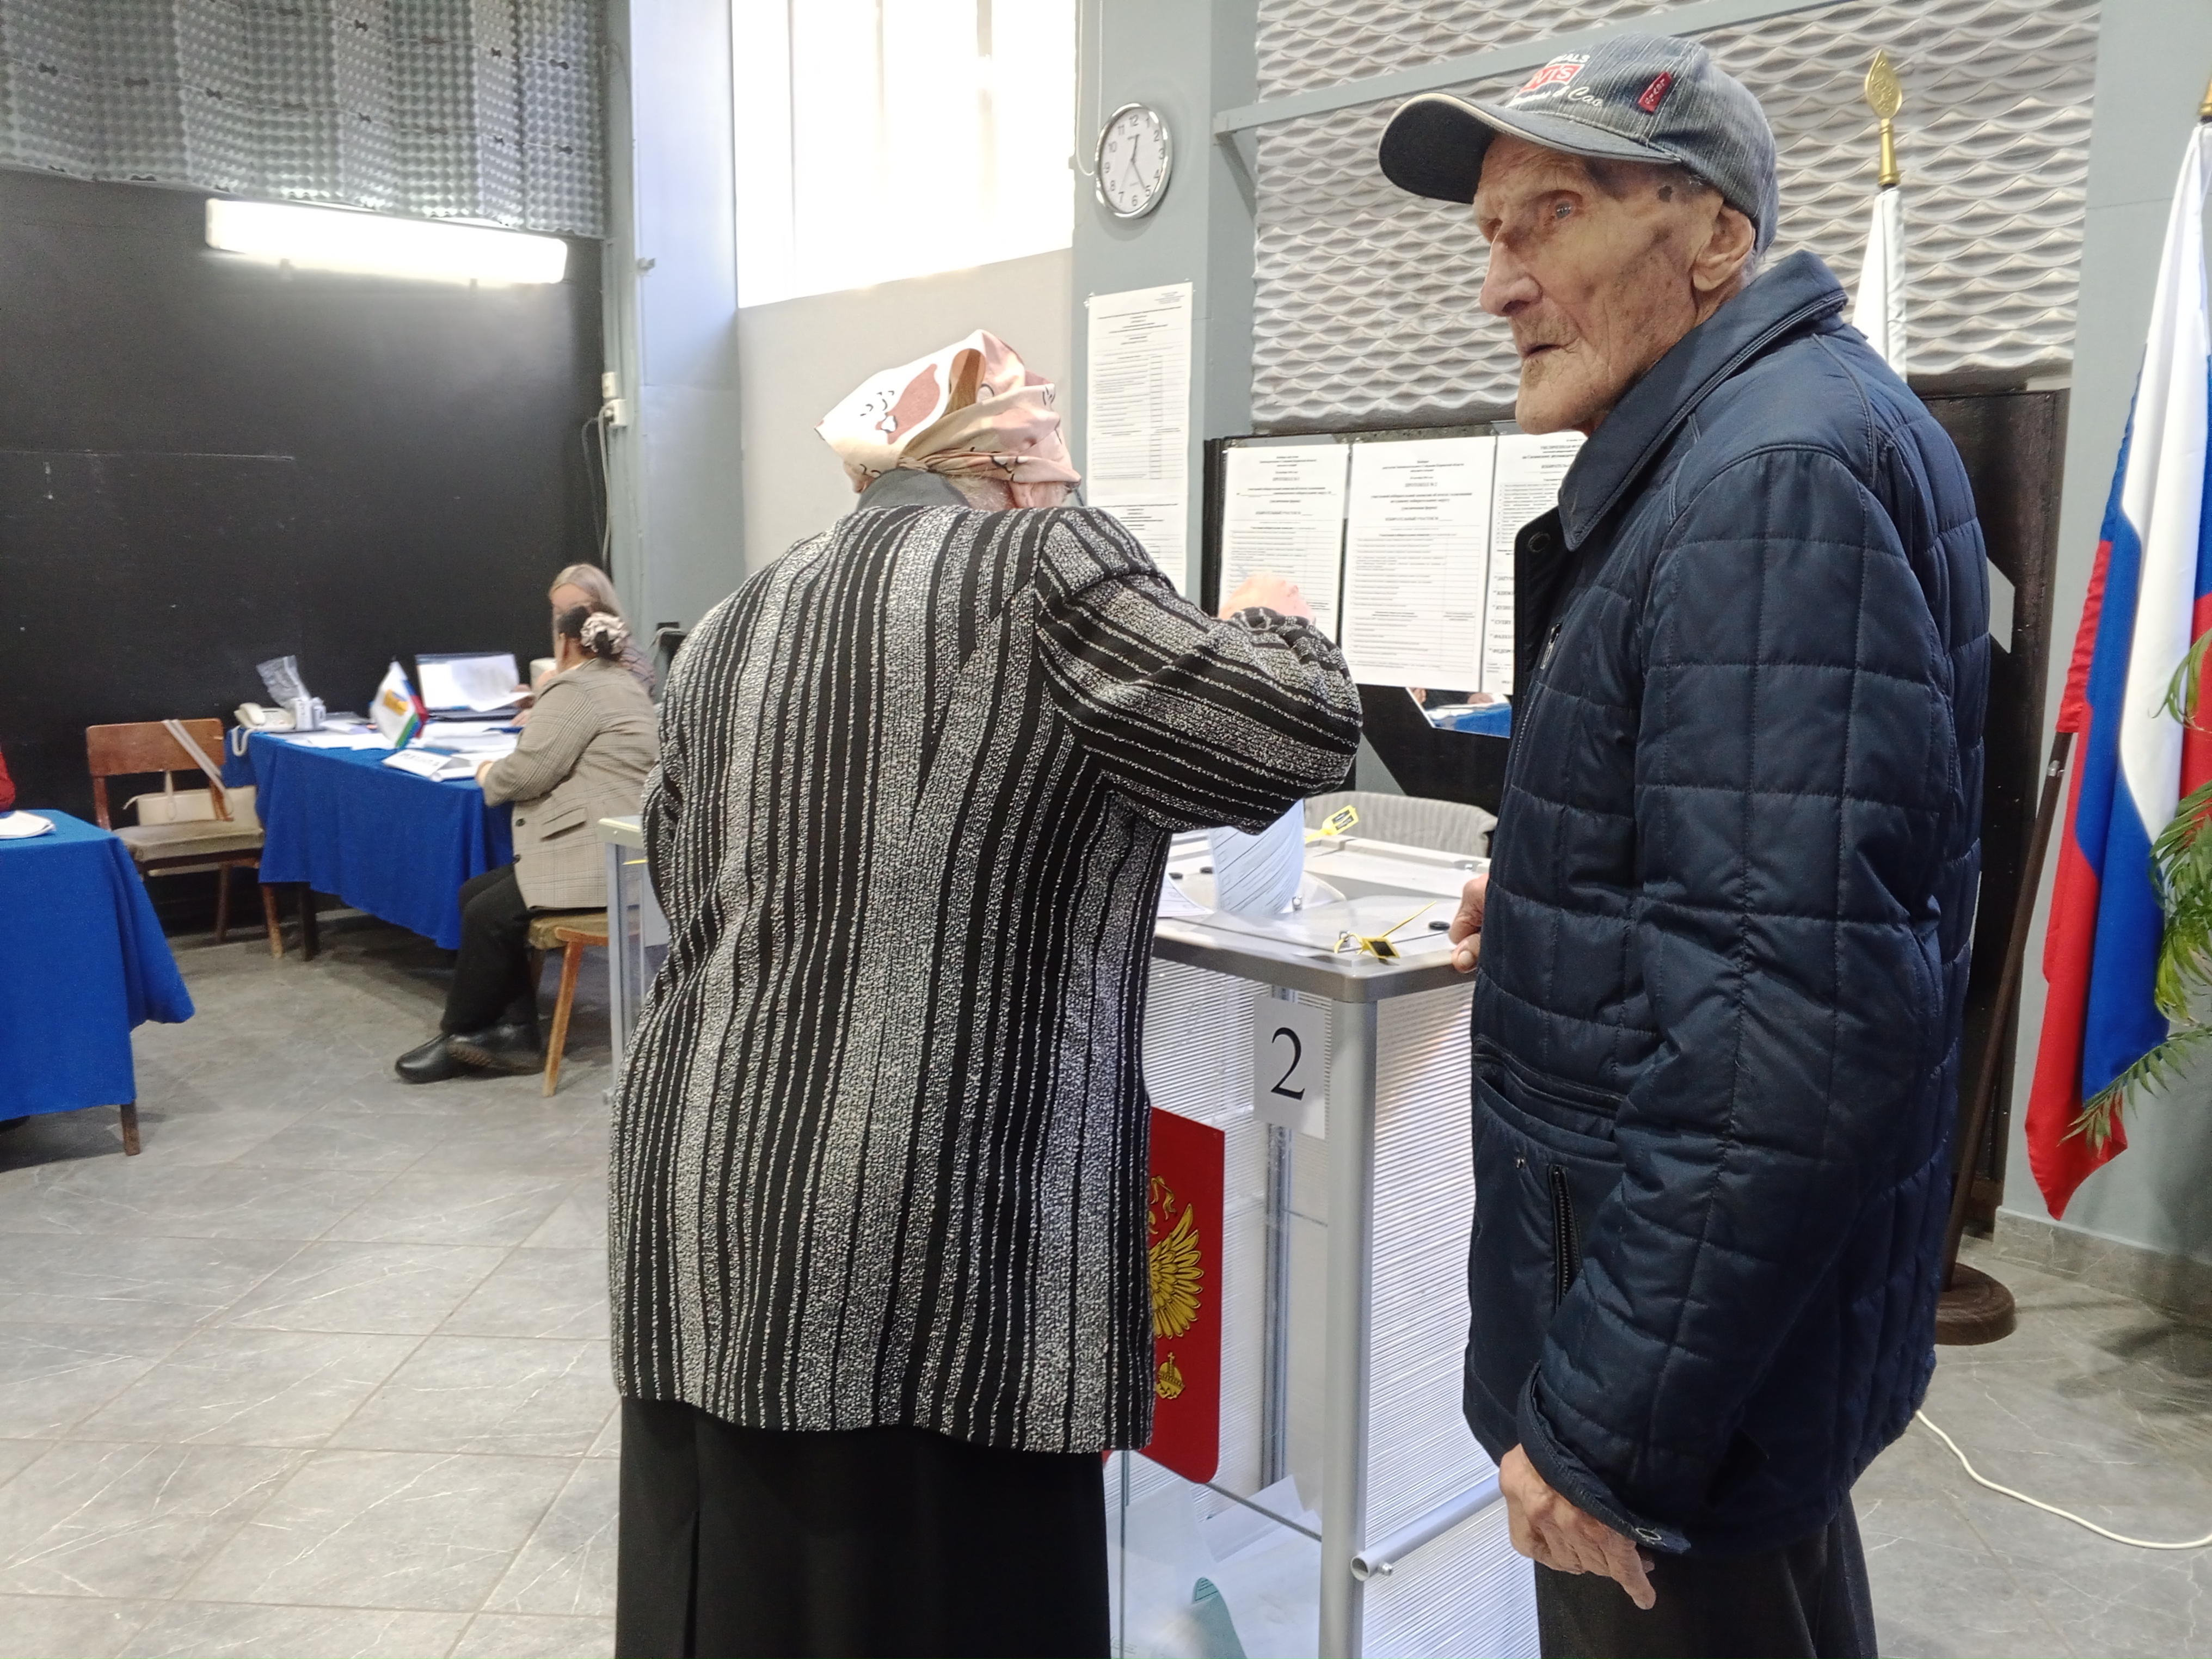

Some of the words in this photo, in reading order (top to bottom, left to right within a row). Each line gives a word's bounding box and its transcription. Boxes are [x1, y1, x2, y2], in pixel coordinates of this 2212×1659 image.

[1128, 114, 1139, 126] 12
[1145, 117, 1150, 128] 1
[1117, 125, 1125, 136] 11
[1153, 130, 1160, 142] 2
[1108, 141, 1117, 153] 10
[1158, 148, 1165, 160] 3
[1103, 162, 1110, 174] 9
[1110, 180, 1116, 192] 8
[1144, 185, 1151, 197] 5
[1118, 191, 1125, 204] 7
[1132, 195, 1138, 207] 6
[1270, 1027, 1306, 1101] 2
